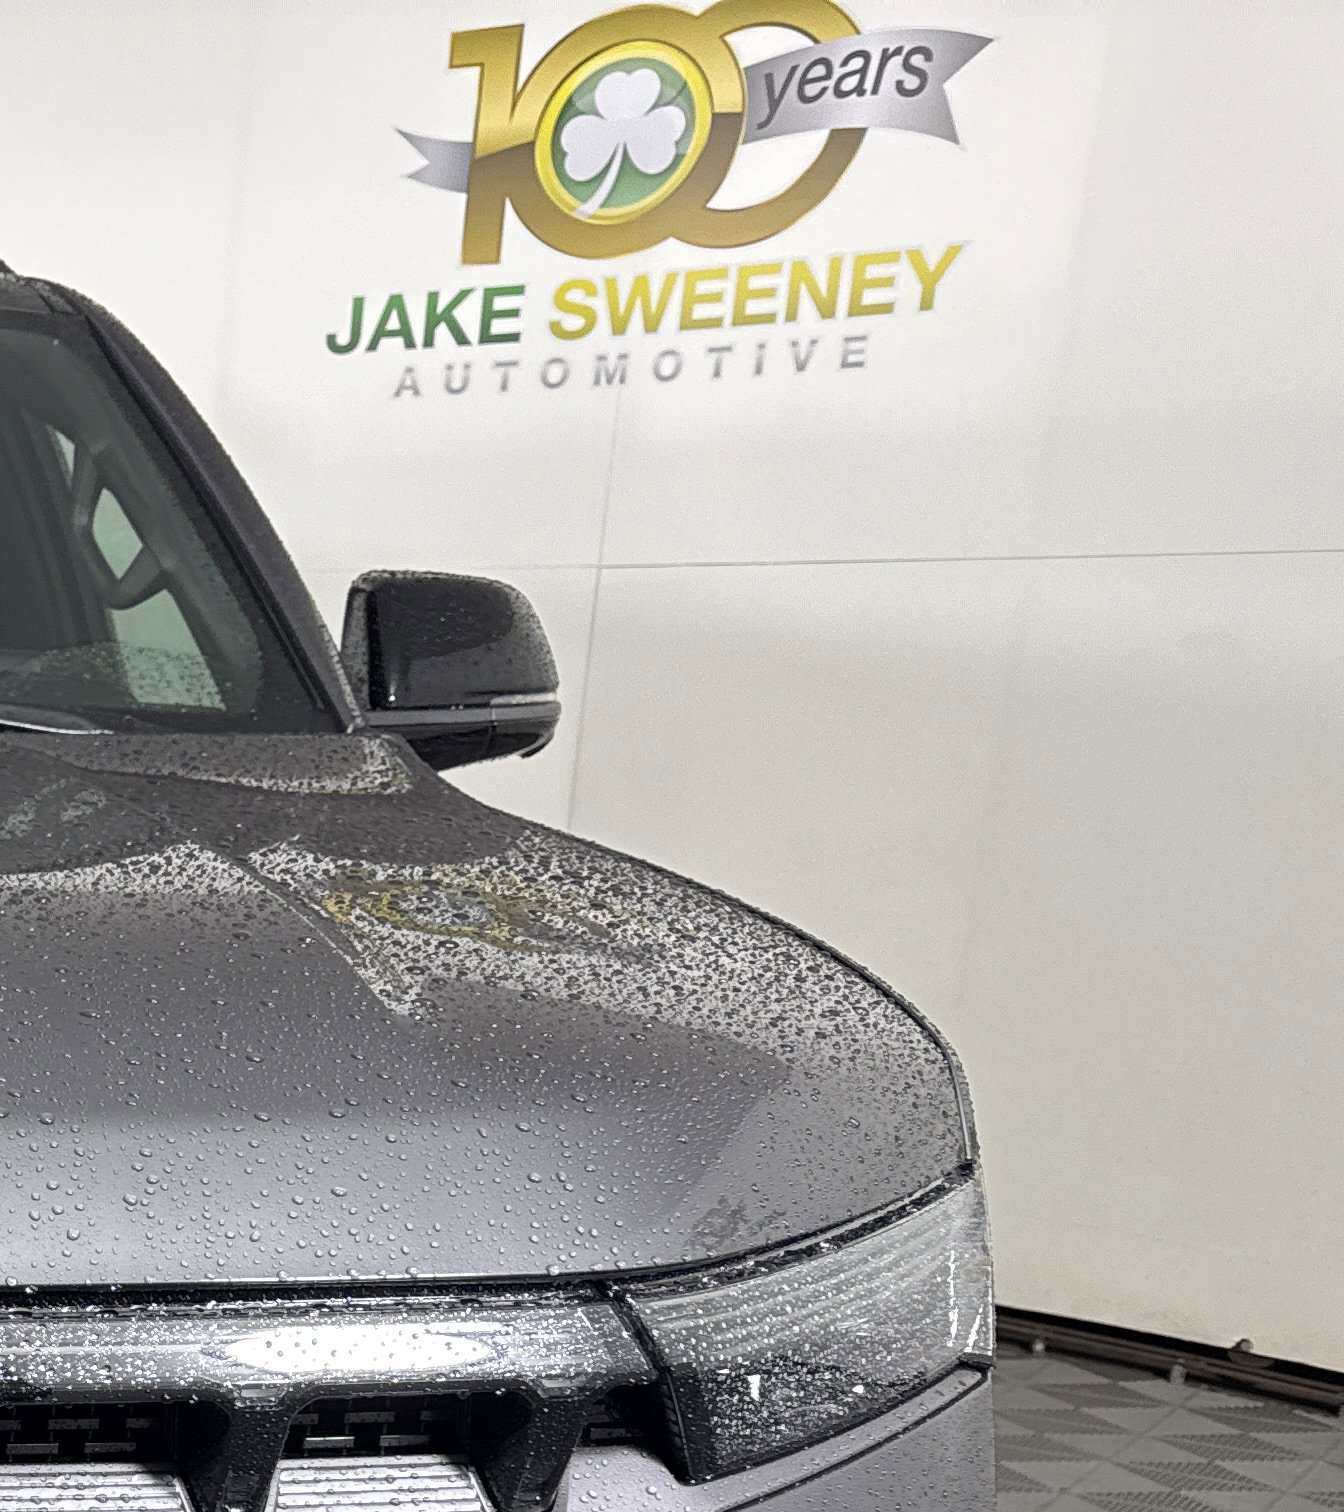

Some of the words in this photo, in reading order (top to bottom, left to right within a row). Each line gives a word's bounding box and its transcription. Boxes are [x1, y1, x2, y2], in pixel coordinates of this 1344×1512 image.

[758, 43, 933, 129] years
[326, 284, 526, 355] JAKE
[547, 242, 965, 341] SWEENEY
[393, 334, 869, 398] AUTOMOTIVE
